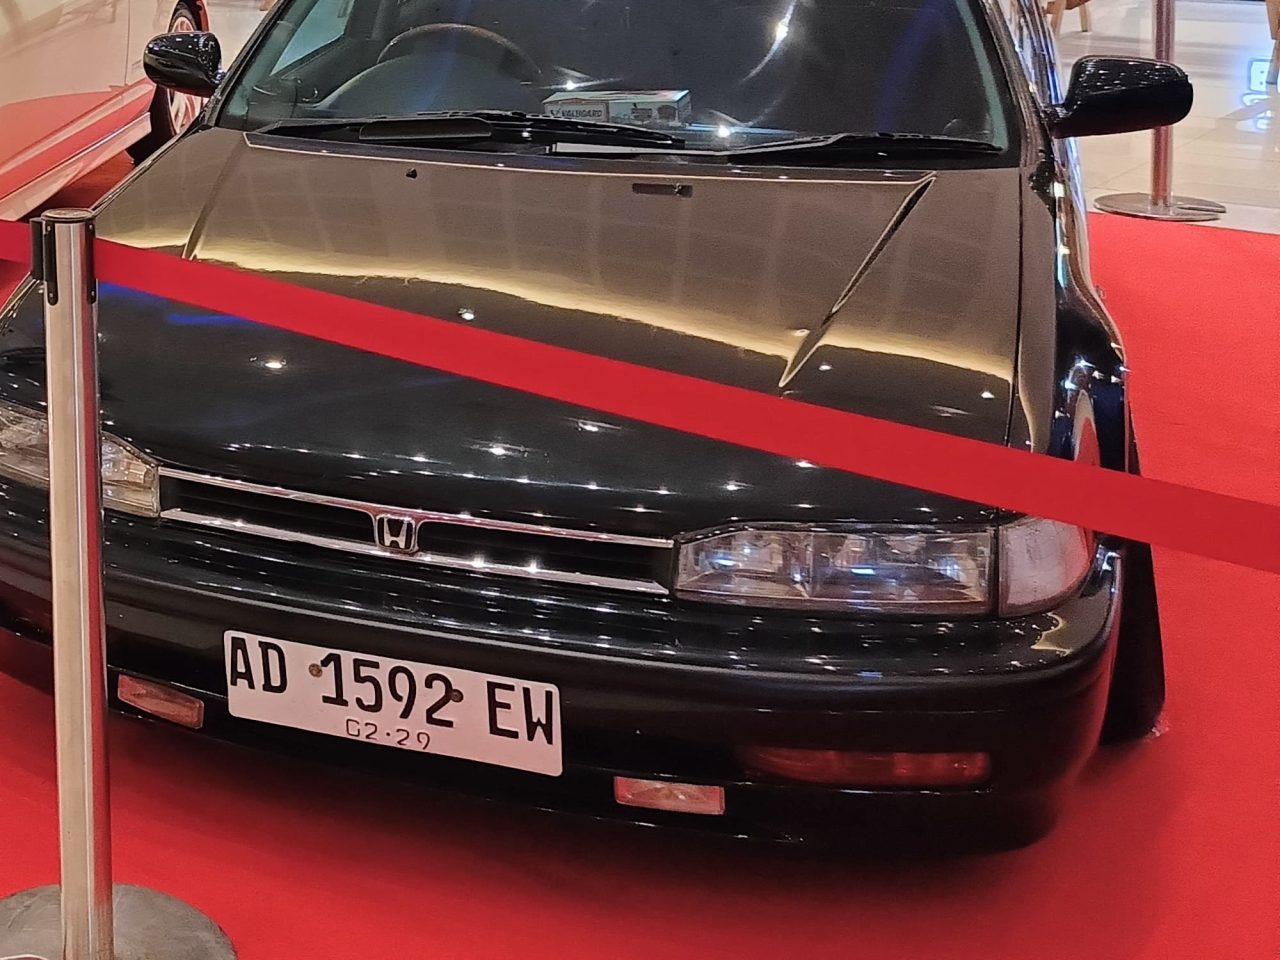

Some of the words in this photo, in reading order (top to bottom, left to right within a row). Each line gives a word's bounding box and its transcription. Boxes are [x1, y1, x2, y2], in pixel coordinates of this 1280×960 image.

[230, 636, 288, 694] AD
[320, 652, 455, 729] 1592
[486, 680, 554, 746] EW
